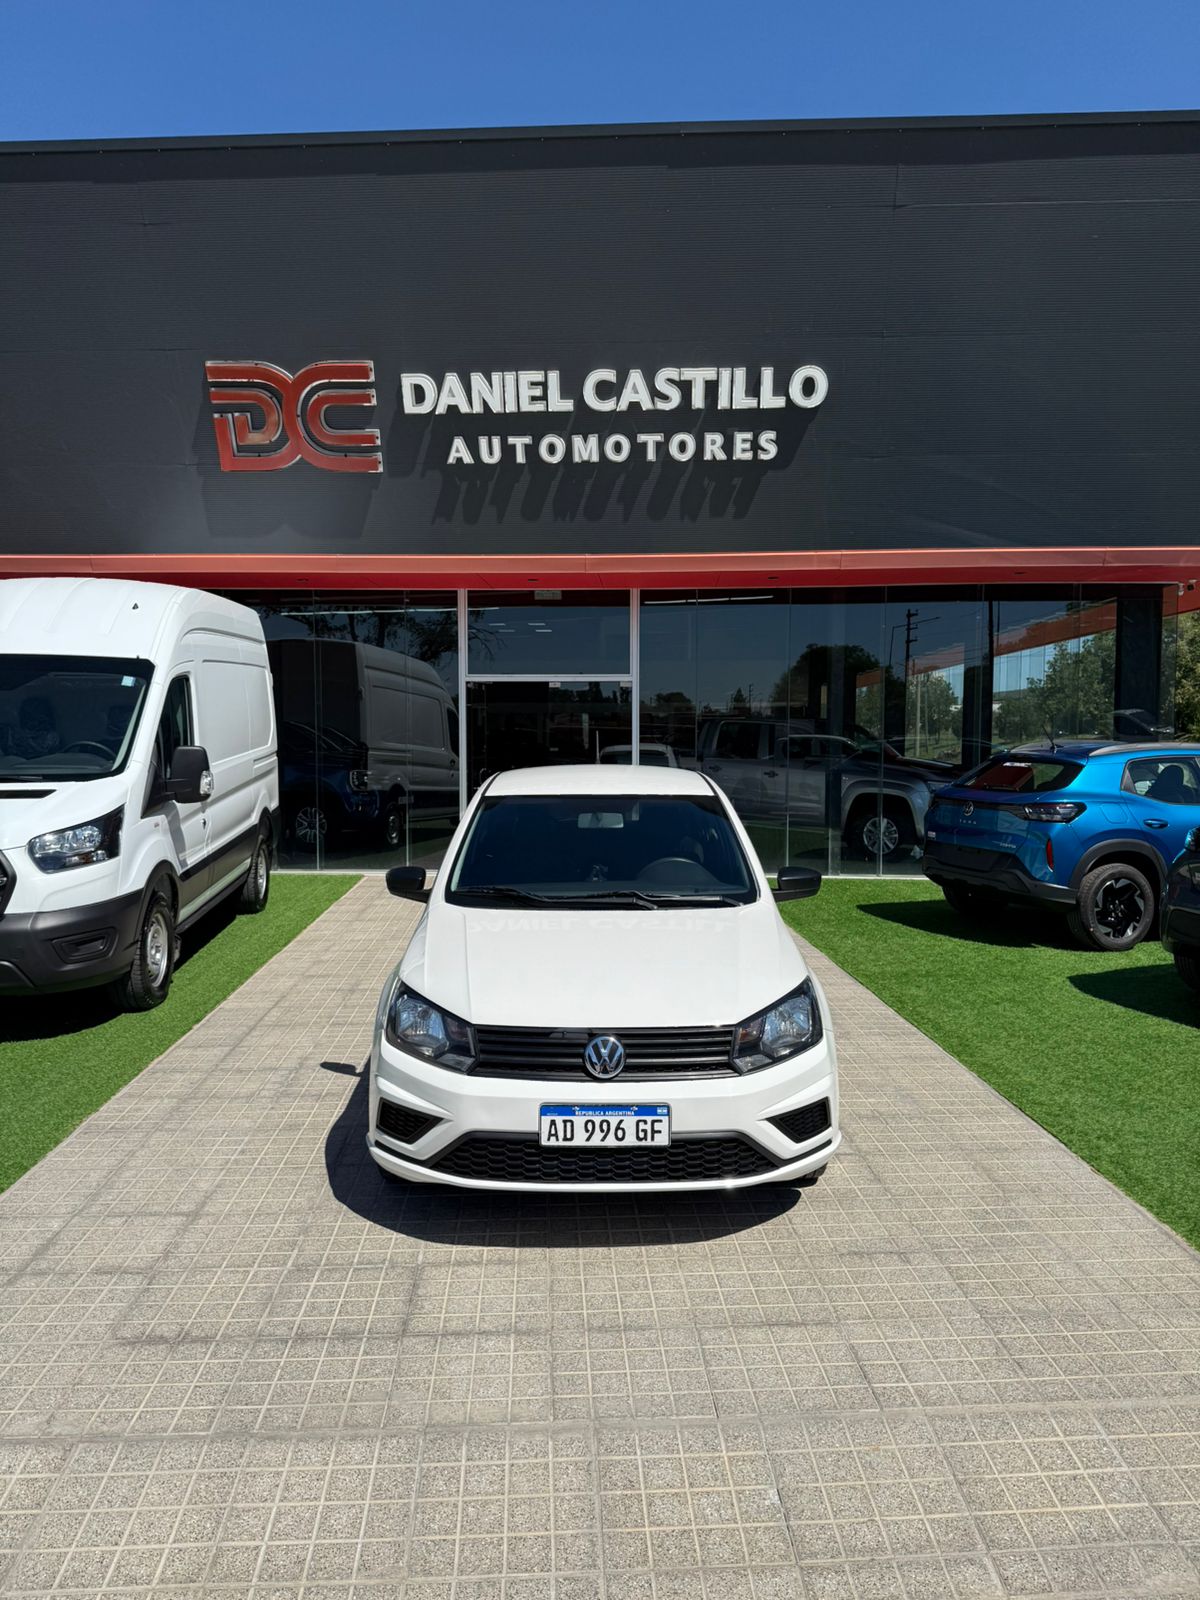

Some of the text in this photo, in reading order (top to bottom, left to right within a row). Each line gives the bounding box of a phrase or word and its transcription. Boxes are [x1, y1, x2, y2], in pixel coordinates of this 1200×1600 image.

[401, 365, 829, 414] DANIEL CASTILLO
[447, 430, 778, 464] AUTOMOTORES
[546, 1119, 663, 1142] AD 996 GF
